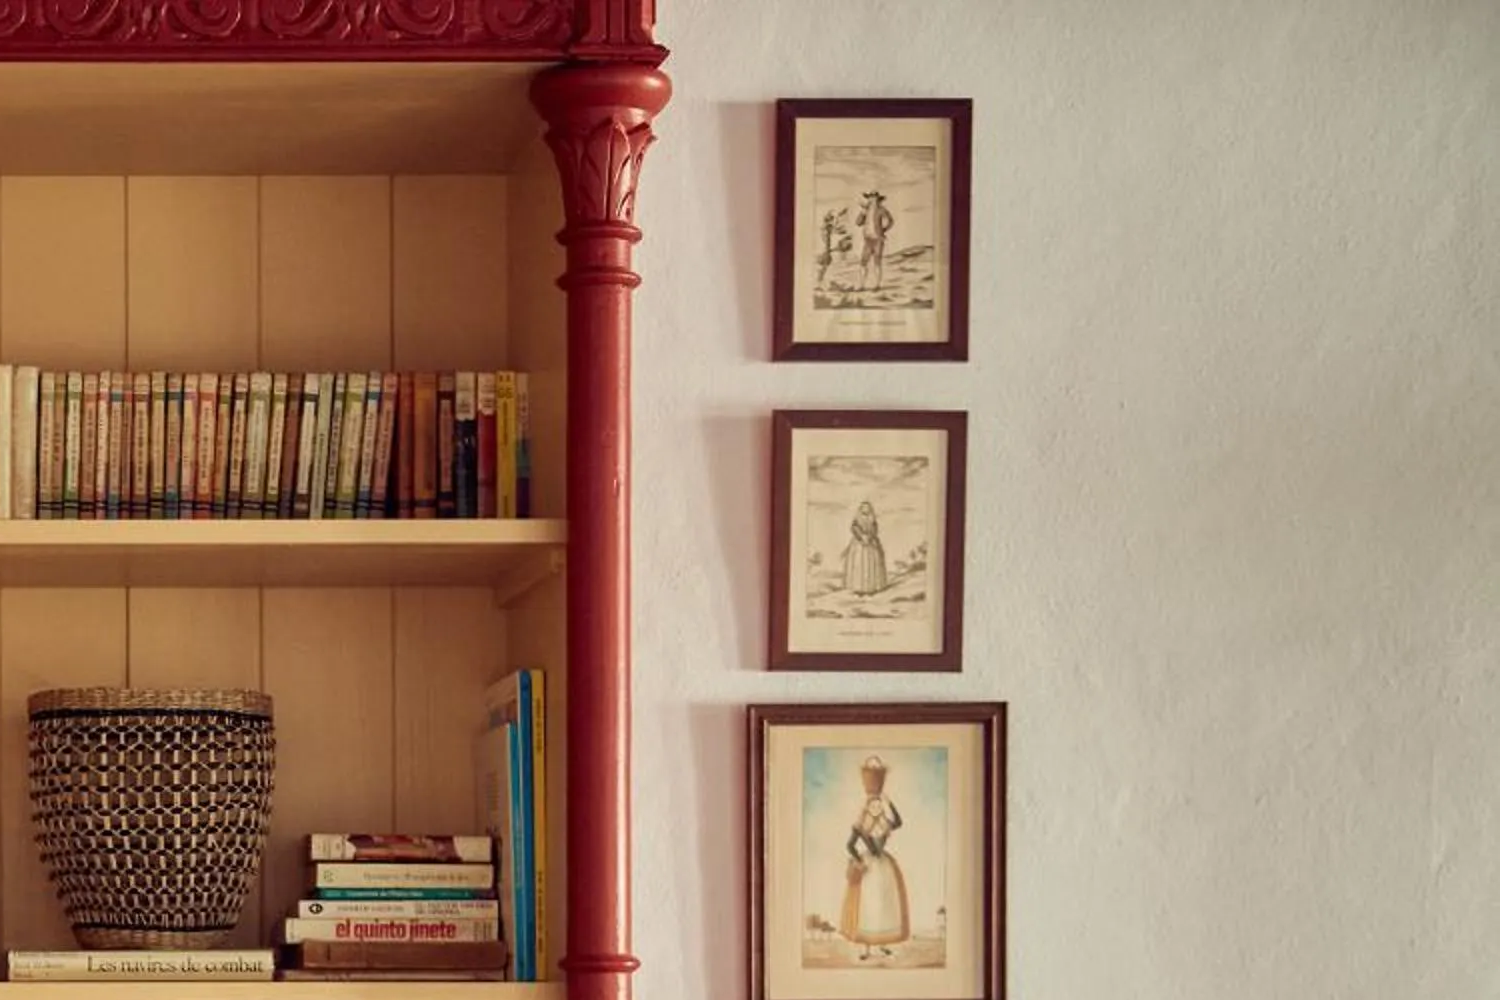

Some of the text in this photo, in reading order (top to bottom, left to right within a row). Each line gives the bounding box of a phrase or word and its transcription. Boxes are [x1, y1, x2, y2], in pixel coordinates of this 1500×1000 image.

[335, 919, 457, 942] el quinto jinete
[87, 955, 116, 973] Les
[181, 955, 201, 973] de
[205, 956, 264, 973] combat
